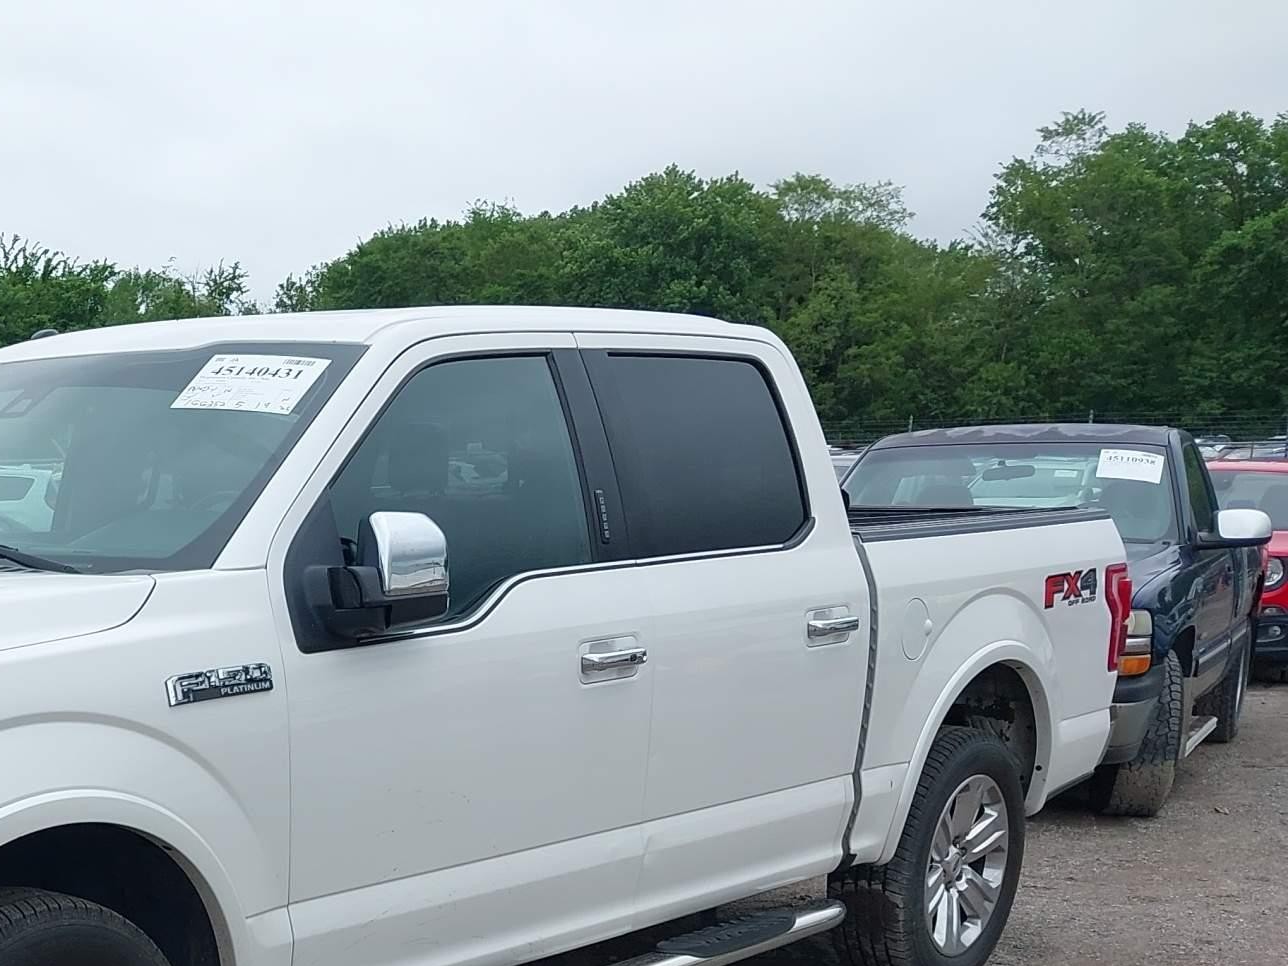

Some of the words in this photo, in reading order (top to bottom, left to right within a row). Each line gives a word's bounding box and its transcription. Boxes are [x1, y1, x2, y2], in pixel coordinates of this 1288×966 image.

[211, 366, 303, 379] 45140431
[1044, 568, 1097, 610] FX4
[221, 681, 271, 695] PLATINUM
